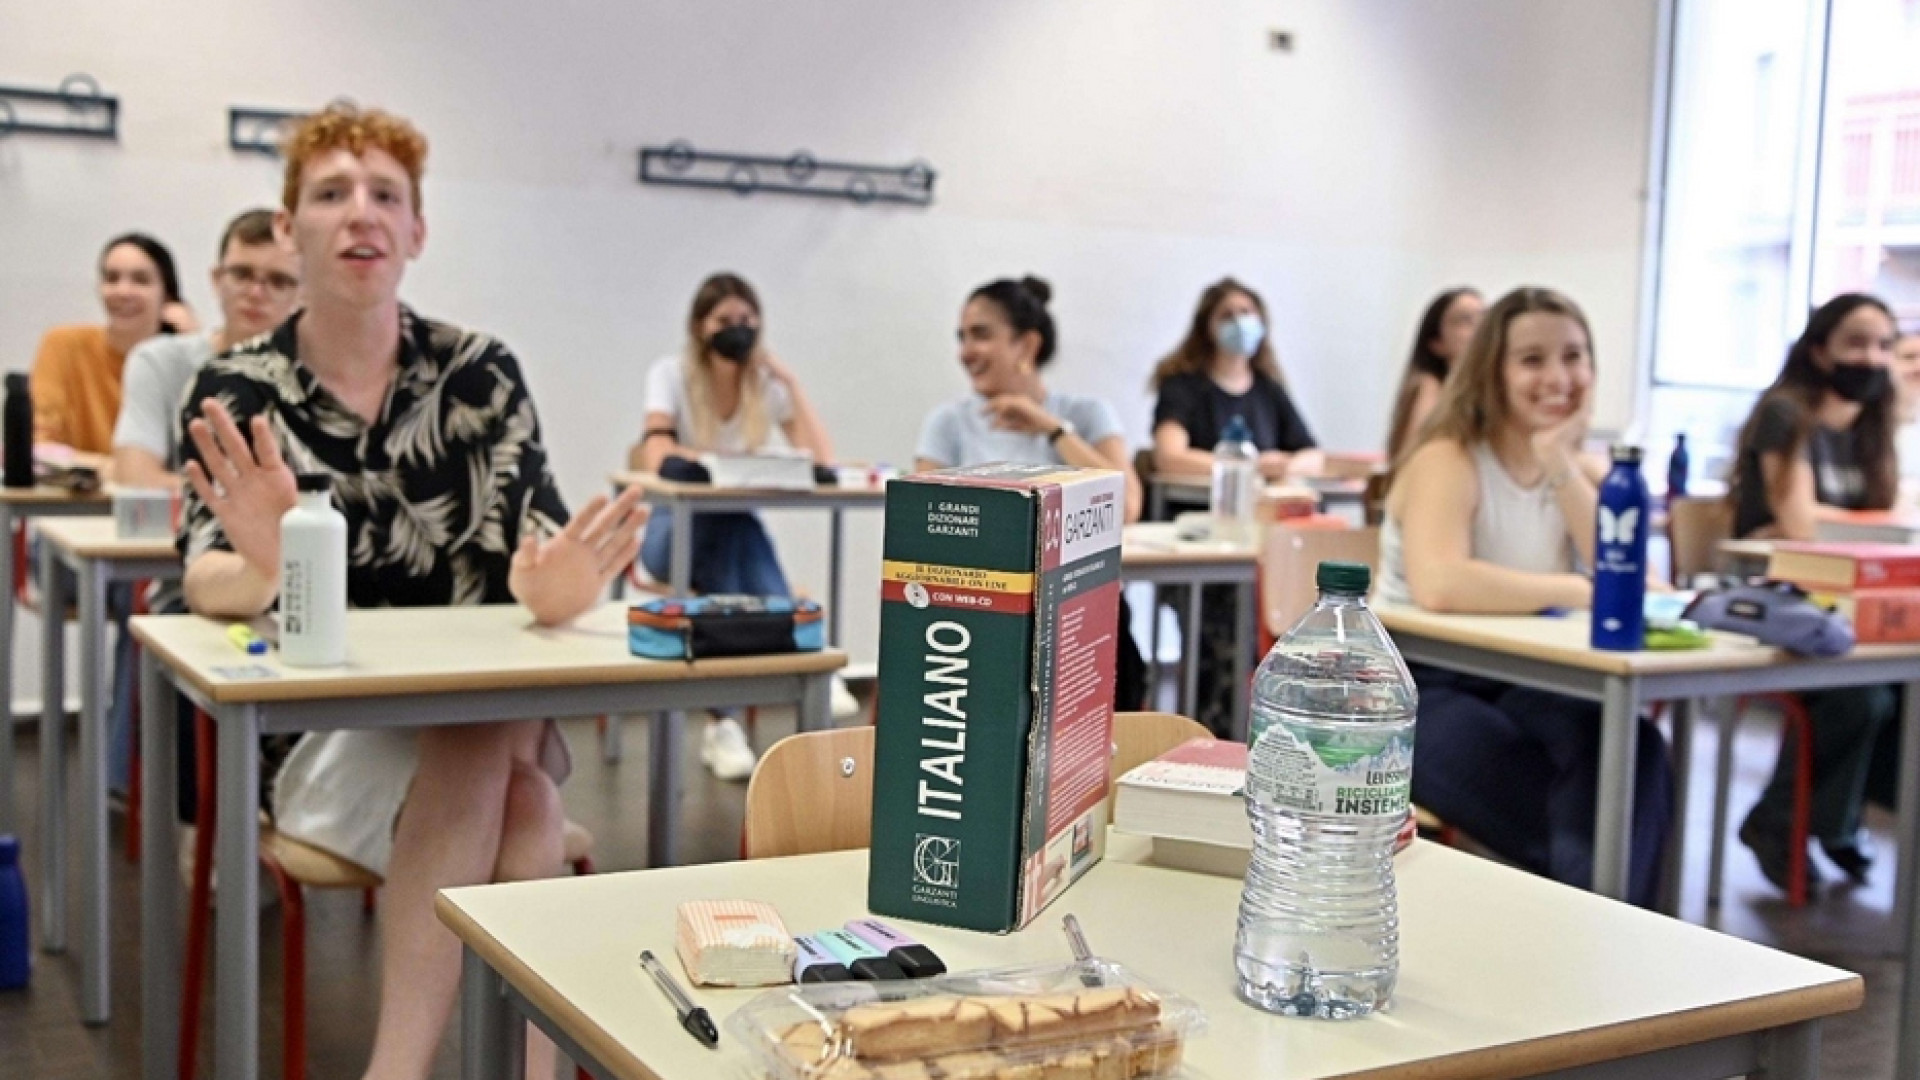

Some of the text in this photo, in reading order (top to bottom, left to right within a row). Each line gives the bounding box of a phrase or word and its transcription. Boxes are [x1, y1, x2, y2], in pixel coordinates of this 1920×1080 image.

[938, 502, 980, 515] GRANDI
[927, 513, 979, 526] DIZIONARI
[1065, 503, 1114, 544] GARZANTI
[927, 524, 979, 538] GARZANTI
[895, 572, 965, 586] AGGIORNABILE
[927, 565, 988, 579] DIZIONARIO
[932, 591, 993, 606] CON WEB-CD
[917, 620, 972, 820] ITALIANO
[912, 884, 958, 900] GARZANTI
